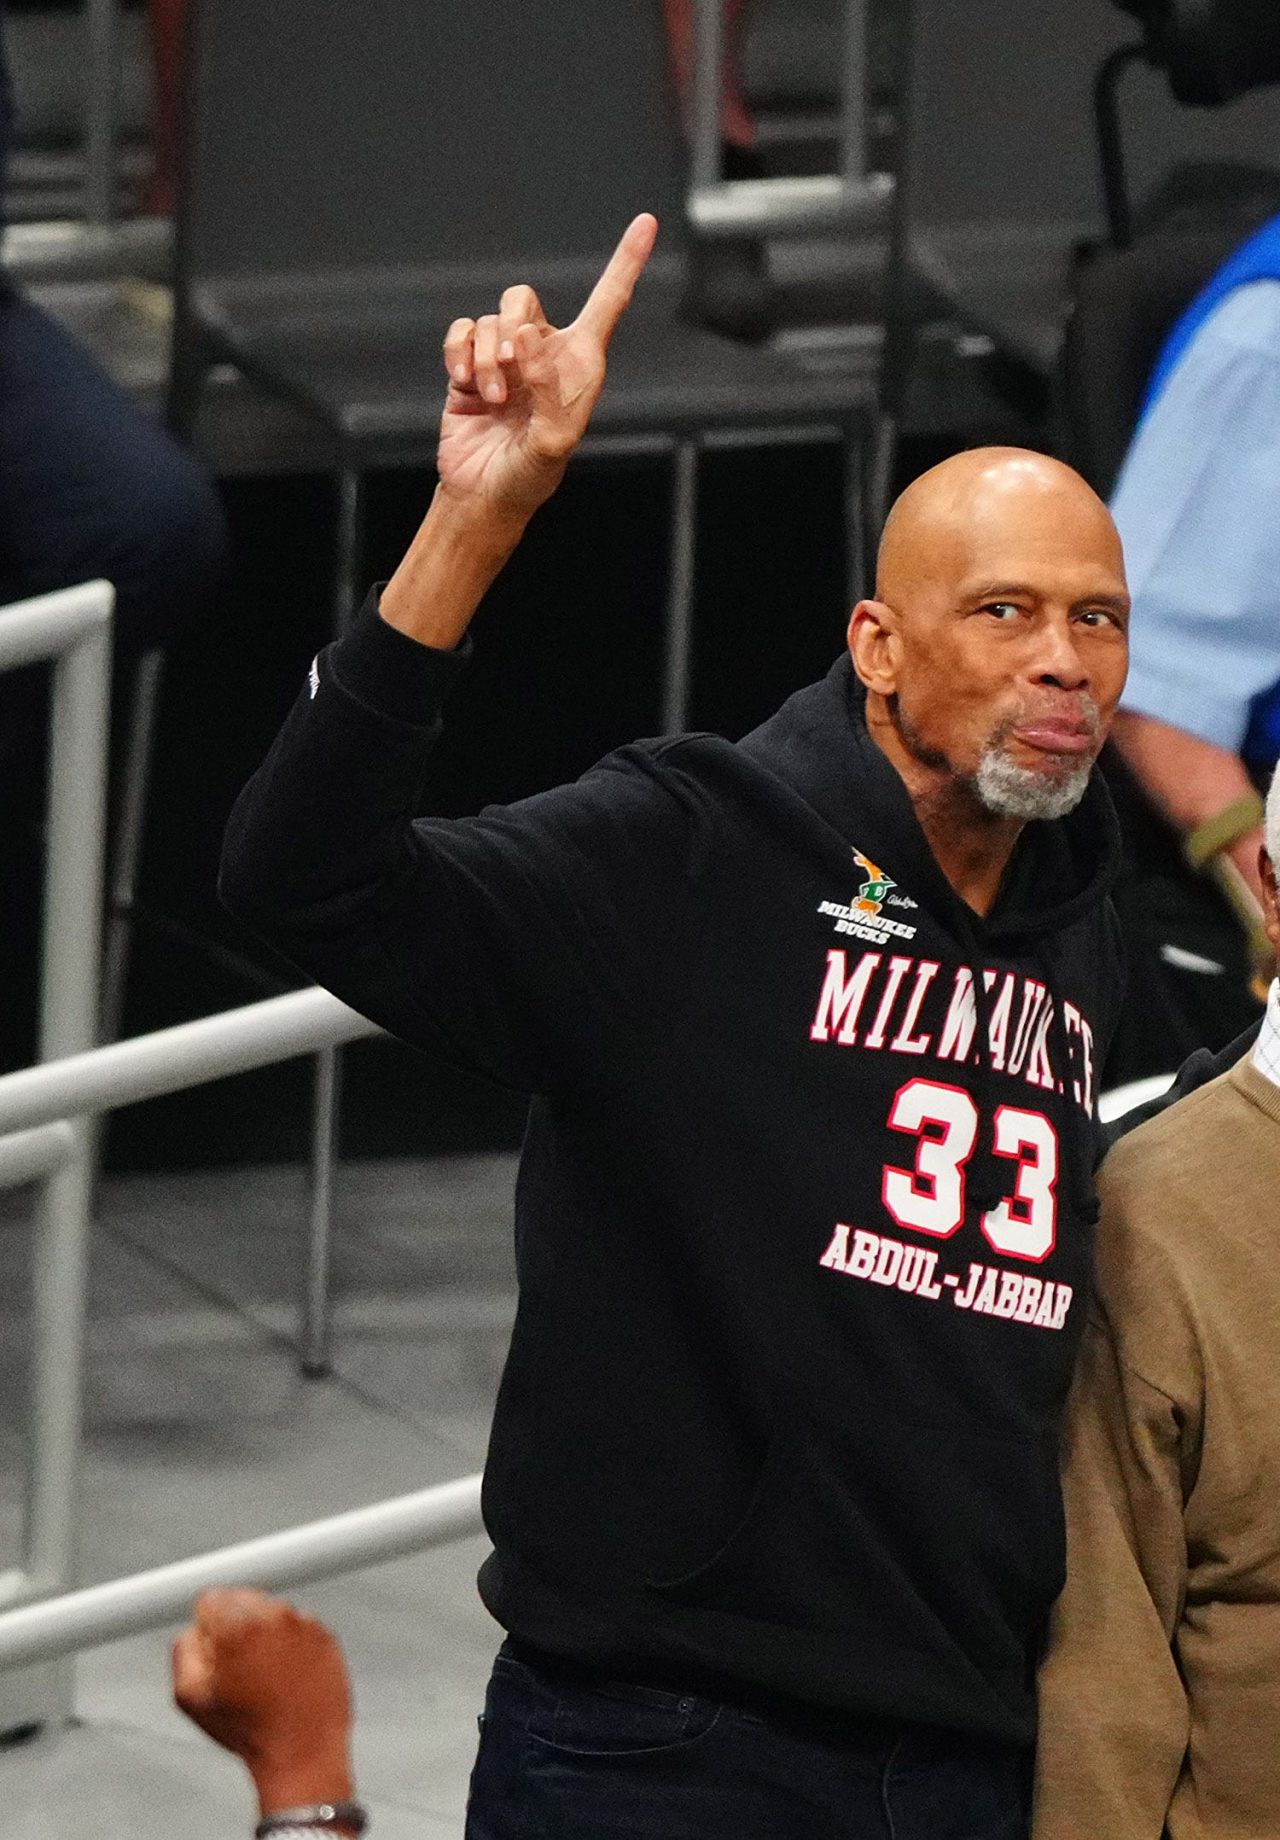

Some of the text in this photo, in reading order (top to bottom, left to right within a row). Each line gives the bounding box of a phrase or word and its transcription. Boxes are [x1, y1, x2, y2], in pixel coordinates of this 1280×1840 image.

[817, 900, 917, 940] MILWAUKEE
[833, 919, 891, 945] BUCKS
[881, 1077, 1059, 1264] 33
[819, 1223, 1073, 1330] ABDUL-JABBAR
